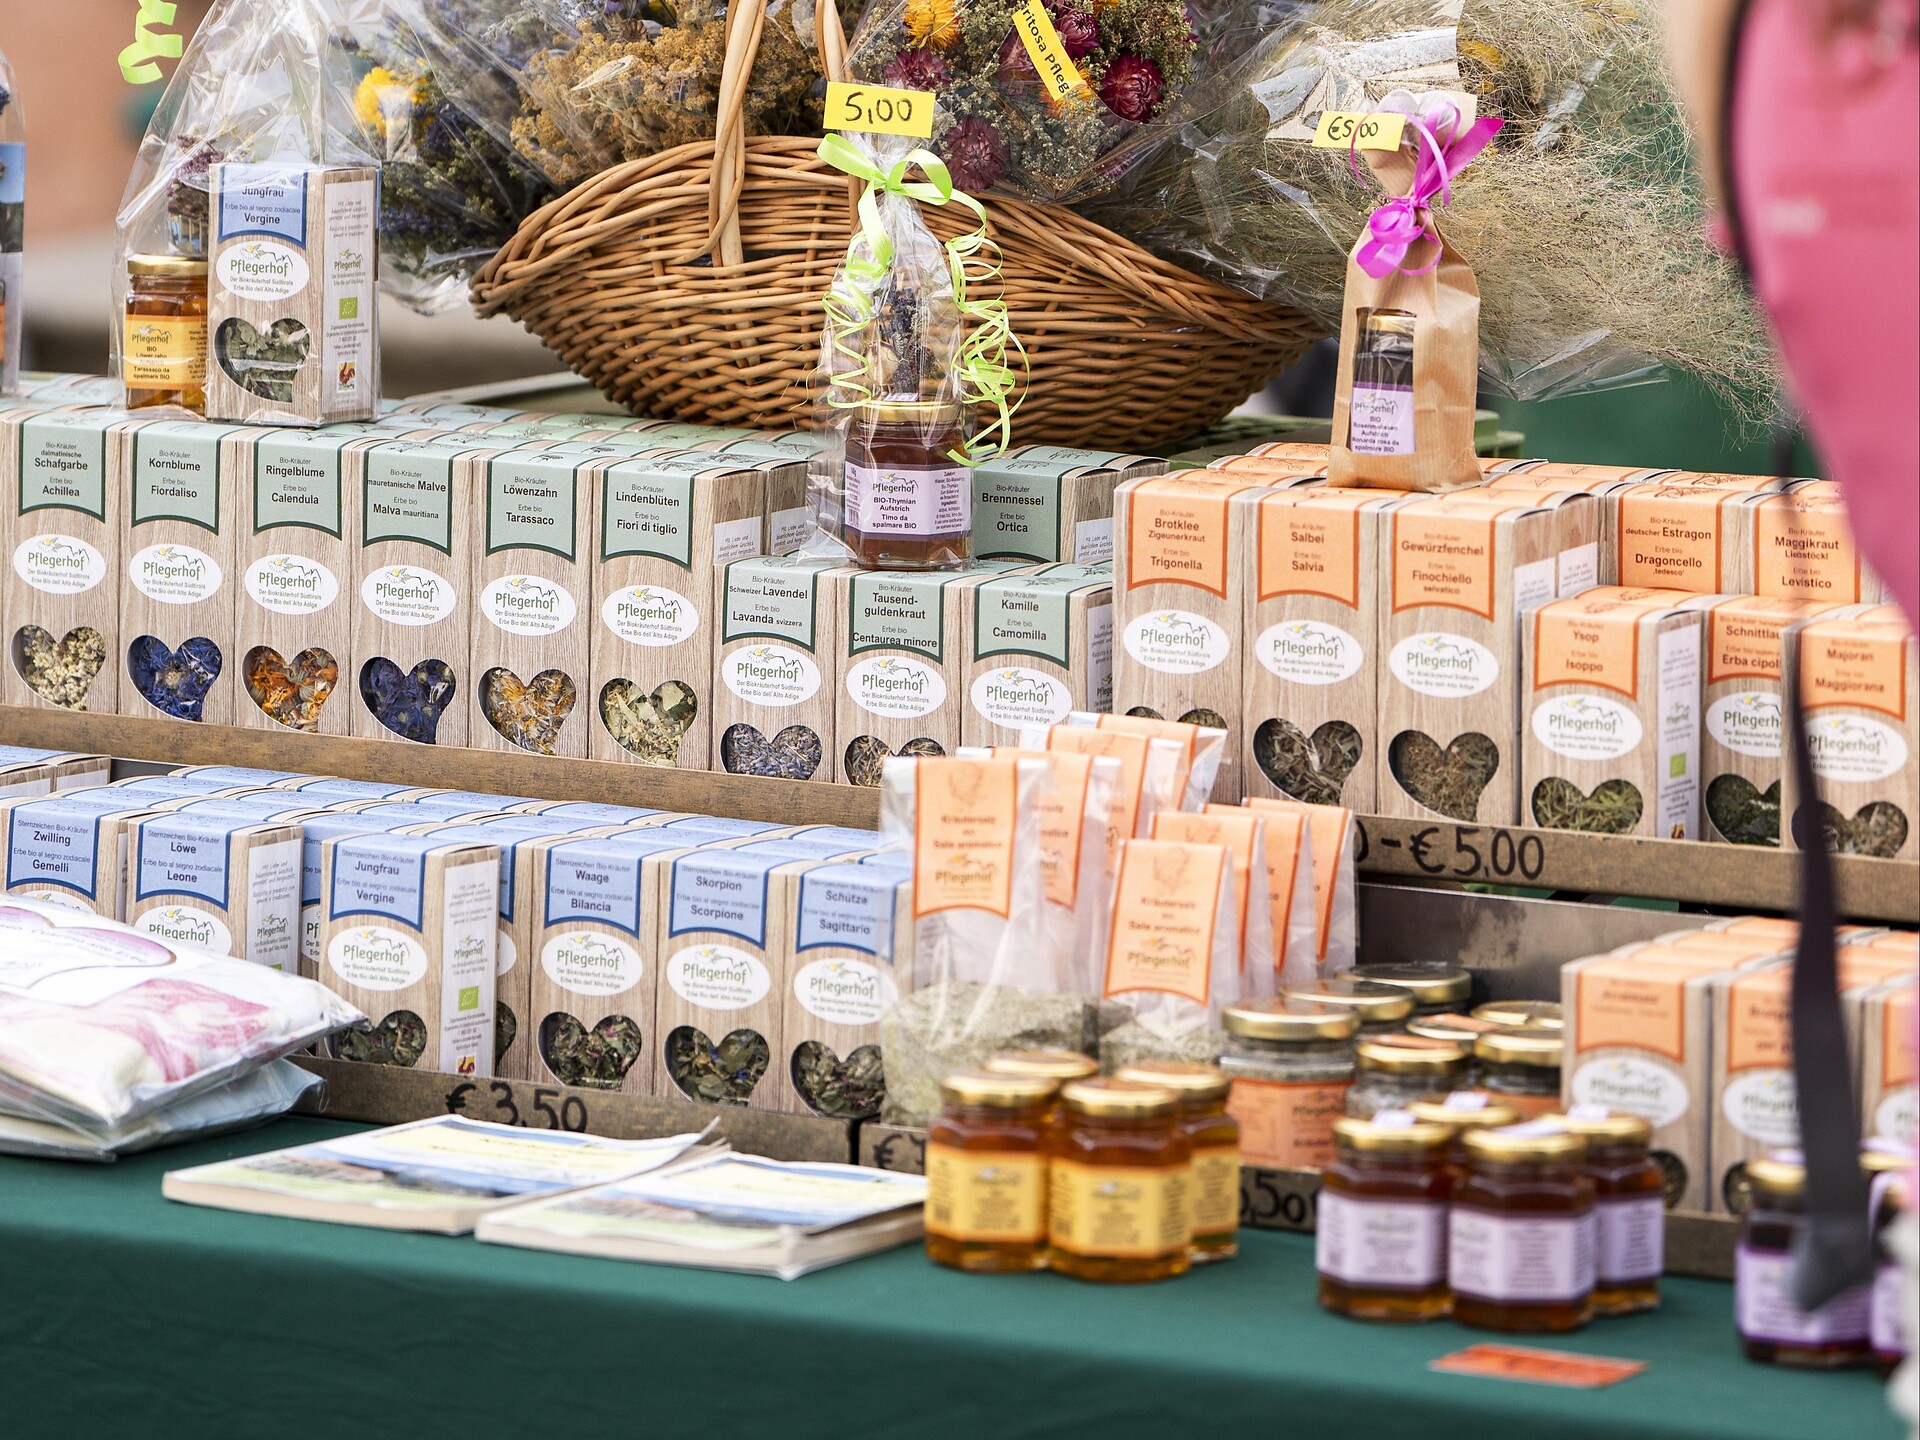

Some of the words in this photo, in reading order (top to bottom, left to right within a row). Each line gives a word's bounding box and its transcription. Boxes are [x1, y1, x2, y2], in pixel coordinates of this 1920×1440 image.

[244, 213, 280, 225] Vergine
[230, 260, 288, 277] Pflegerhof
[334, 259, 361, 270] Pflegerhof
[132, 334, 169, 344] Pflegerhof
[41, 450, 82, 458] dalmatinische
[159, 450, 191, 459] Bio-Kräuter
[279, 457, 311, 465] Bio-Kräuter
[34, 457, 88, 471] Schafgarbe
[149, 457, 201, 471] Kornblume
[266, 465, 325, 478] Ringelblume
[367, 479, 416, 490] mauretanische
[417, 481, 446, 492] Malve
[514, 476, 547, 485] Bio-Kräuter
[42, 485, 80, 497] Achillea
[151, 485, 197, 498] Fiordaliso
[503, 484, 558, 498] Löwenzahn
[632, 484, 664, 493] Bio-Kräuter
[872, 483, 915, 494] Pflegerhof
[996, 484, 1030, 493] Bio-Kräuter
[271, 492, 319, 505] Calendula
[616, 492, 680, 507] Lindenblüten
[873, 497, 916, 505] BIO-Thymian
[982, 493, 1044, 506] Brennnessel
[373, 504, 401, 515] Malva
[403, 509, 439, 519] mauritiana
[1000, 512, 1014, 520] Erbe
[506, 512, 554, 526] Tarassaco
[1154, 518, 1200, 531] Brotklee
[1650, 517, 1687, 526] Bio-Kräuter
[617, 519, 639, 531] Fiori
[641, 521, 650, 532] di
[652, 522, 678, 536] tiglio
[997, 521, 1028, 532] Ortica
[1625, 528, 1660, 537] deutscher
[1662, 527, 1712, 540] Estragon
[1148, 530, 1206, 543] Zigeunerkraut
[1291, 531, 1325, 544] Salbei
[1775, 536, 1840, 551] Maggikraut
[1402, 540, 1484, 556] Gewürzfenchel
[1655, 545, 1669, 553] Erbe
[1671, 546, 1682, 554] bio
[28, 552, 85, 571] Pflegerhof
[1150, 556, 1202, 570] Trigonella
[1292, 560, 1325, 573] Salvia
[1635, 553, 1702, 568] Dragoncello
[143, 561, 201, 581] Pflegerhof
[1412, 570, 1472, 585] Finochiello
[259, 572, 317, 591] Pflegerhof
[752, 576, 786, 585] Bio-Kräuter
[1781, 576, 1832, 589] Levistico
[376, 583, 434, 602] Pflegerhof
[729, 586, 761, 595] Schweizer
[763, 586, 808, 599] Lavendel
[878, 584, 913, 593] Bio-Kräuter
[1003, 590, 1038, 599] Bio-Kräuter
[1423, 585, 1460, 595] selvatico
[495, 592, 554, 612] Pflegerhof
[872, 592, 918, 605] Tausend-
[1001, 599, 1039, 612] Kamille
[617, 603, 677, 623] Pflegerhof
[755, 604, 769, 612] Erbe
[771, 605, 780, 613] bio
[864, 606, 926, 620] guldenkraut
[733, 611, 774, 625] Lavanda
[776, 618, 803, 627] svizzera
[1007, 619, 1021, 627] Erbe
[882, 625, 896, 633] Erbe
[992, 627, 1047, 641] Camomilla
[852, 633, 901, 646] Centaurea
[904, 637, 938, 648] minore
[1141, 628, 1205, 649] Pflegerhof
[1573, 631, 1599, 643] Ysop
[1273, 640, 1339, 660] Pflegerhof
[1827, 649, 1874, 662] Majoran
[1407, 652, 1474, 672] Pflegerhof
[1566, 659, 1603, 673] Isoppo
[1722, 654, 1748, 666] Erba
[737, 663, 799, 682] Pflegerhof
[862, 674, 924, 694] Pflegerhof
[1815, 678, 1885, 693] Maggiorana
[986, 685, 1049, 705] Pflegerhof
[1550, 715, 1617, 733] Pflegerhof
[1808, 735, 1880, 754] Pflegerhof
[18, 819, 55, 830] Sternzeichen
[57, 822, 89, 834] Bio-Kräuter
[33, 831, 71, 846] Zwilling
[13, 847, 26, 855] Erbe
[27, 849, 37, 857] bio
[44, 851, 61, 860] segno
[62, 853, 91, 863] zodiacale
[170, 842, 196, 854] Löwe
[32, 859, 69, 873] Gemelli
[355, 861, 399, 875] Jungfrau
[167, 870, 197, 883] Leone
[575, 870, 609, 884] Waage
[695, 876, 742, 891] Skorpion
[935, 871, 993, 885] Pflegerhof
[356, 890, 395, 904] Vergine
[825, 891, 868, 905] Schütze
[571, 899, 611, 913] Bilancia
[690, 905, 744, 920] Scorpione
[149, 923, 210, 945] Pflegerhof
[257, 923, 286, 938] Pflegerhof
[819, 919, 871, 935] Sagittario
[343, 945, 404, 965] Pflegerhof
[454, 946, 484, 960] Pflegerhof
[557, 950, 620, 970] Pflegerhof
[683, 963, 747, 983] Pflegerhof
[810, 977, 875, 999] Pflegerhof
